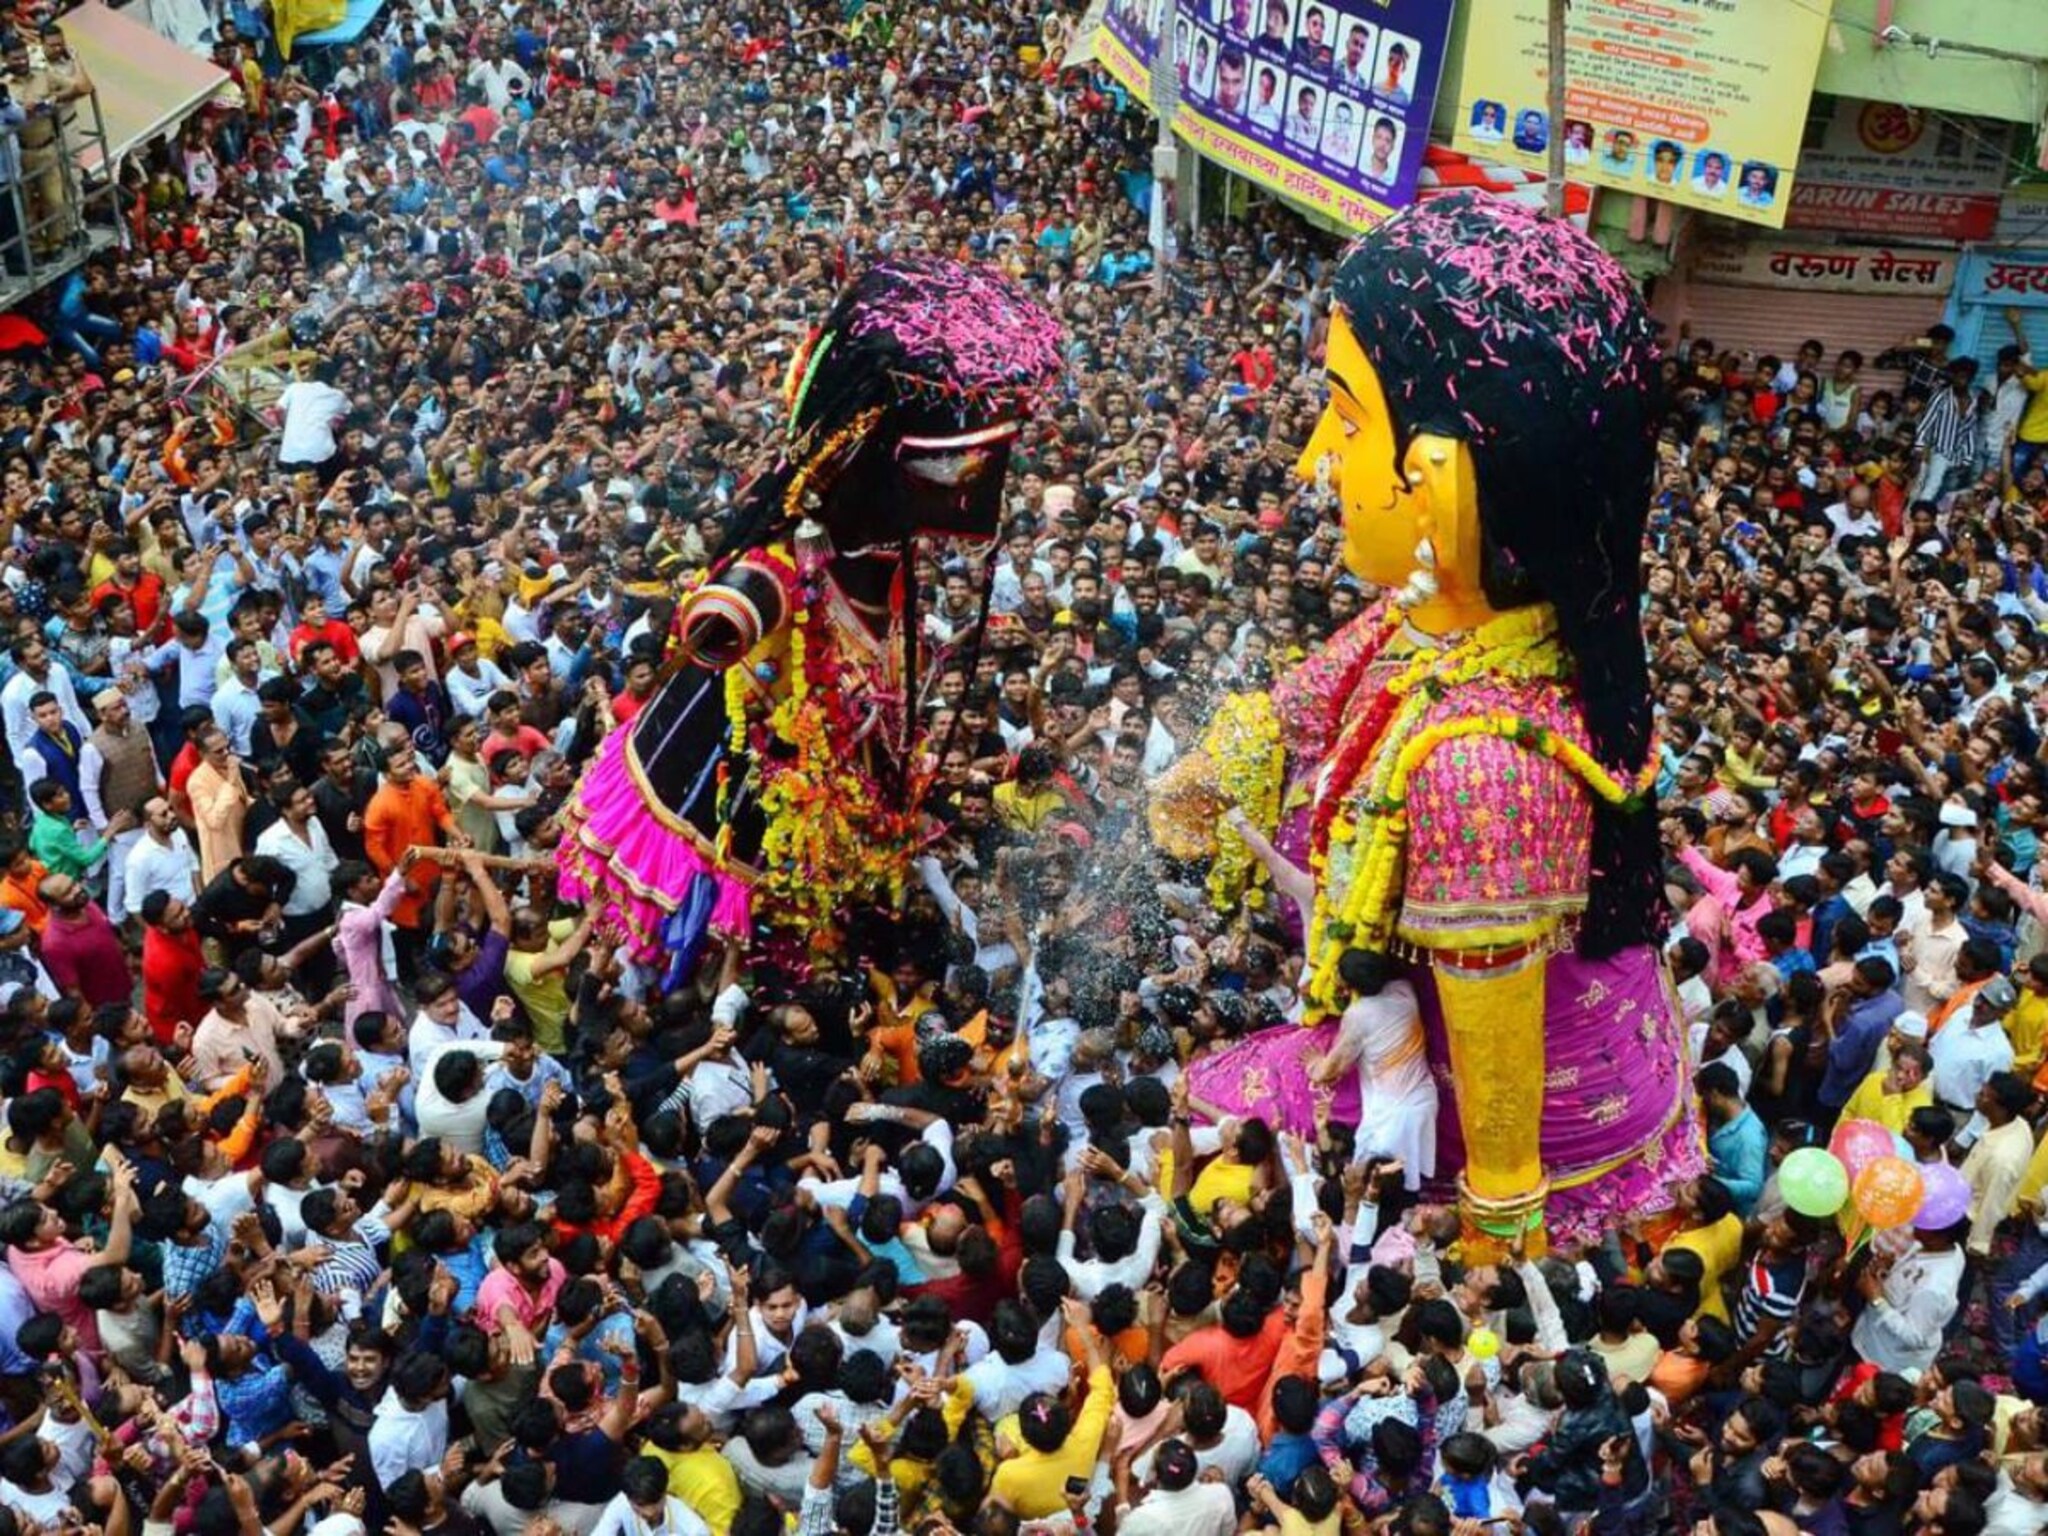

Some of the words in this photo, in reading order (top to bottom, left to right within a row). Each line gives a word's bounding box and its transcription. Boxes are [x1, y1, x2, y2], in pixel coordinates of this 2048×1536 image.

[1283, 169, 1334, 205] हार्दिक
[1883, 191, 1970, 215] SALES
[1868, 250, 1942, 284] सेल्स
